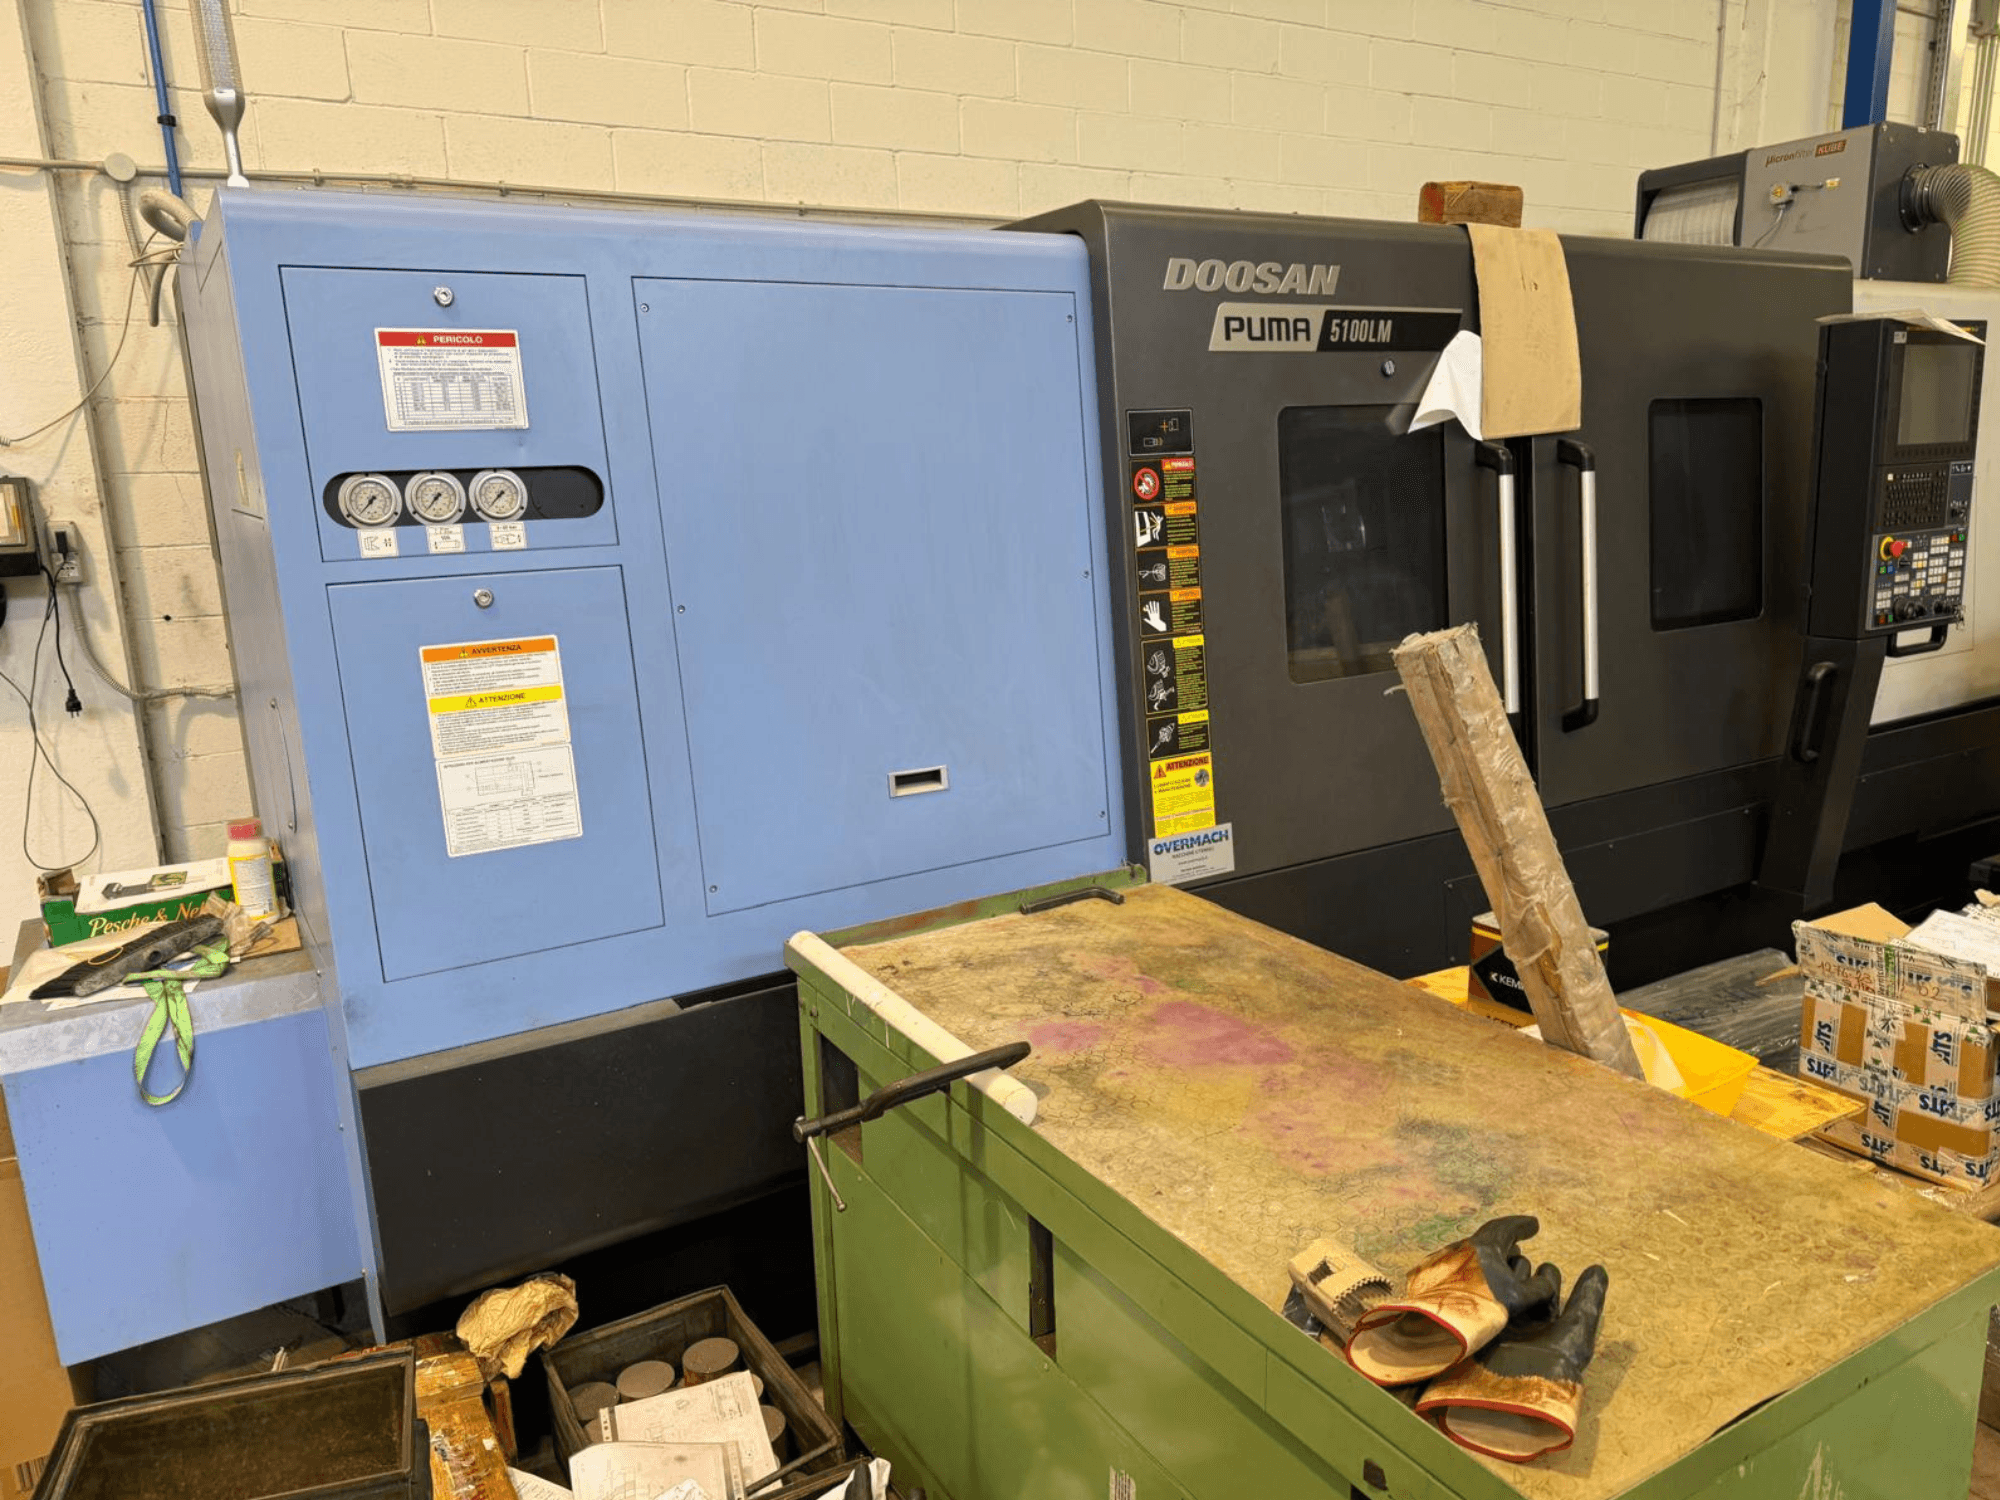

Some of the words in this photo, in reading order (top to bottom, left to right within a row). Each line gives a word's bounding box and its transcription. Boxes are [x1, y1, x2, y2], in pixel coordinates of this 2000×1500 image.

[1163, 257, 1341, 296] DOOSAN
[433, 335, 483, 344] PERICOLO
[1223, 316, 1312, 342] PUMA
[1330, 318, 1393, 343] 5100LM
[471, 643, 522, 655] AVVERTENZA
[478, 692, 526, 704] ATTENZIONE
[1165, 756, 1210, 772] ATTENZIONE
[1153, 829, 1230, 856] OVERMACH
[89, 912, 150, 938] Pesche
[153, 907, 168, 922] &
